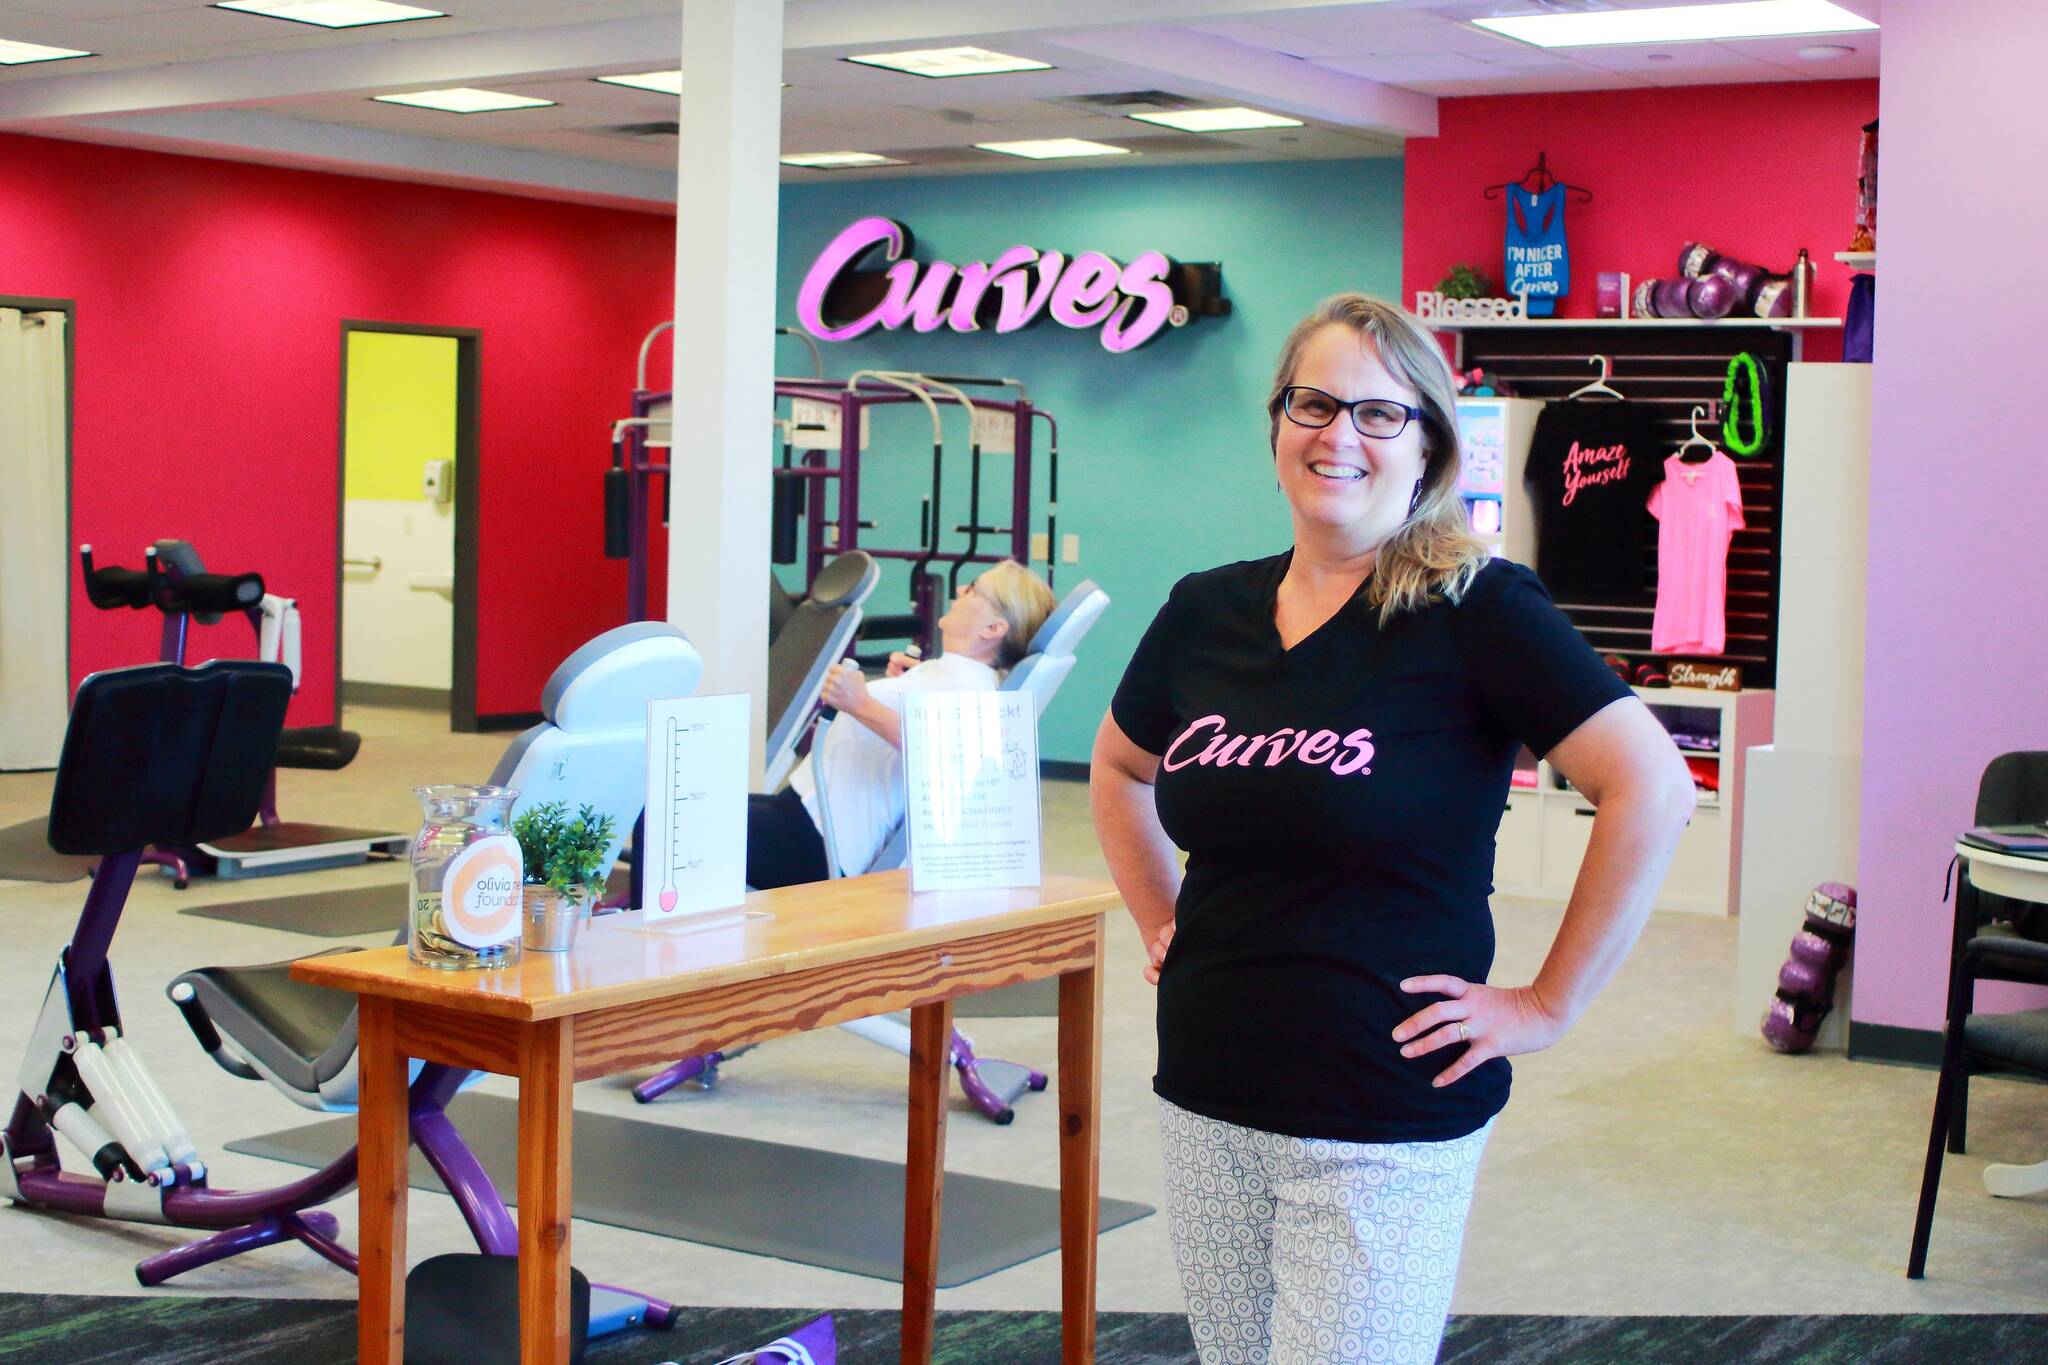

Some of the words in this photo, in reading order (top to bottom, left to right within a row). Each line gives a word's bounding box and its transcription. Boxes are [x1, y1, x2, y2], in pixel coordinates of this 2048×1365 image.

[1508, 246, 1525, 261] I'M
[1526, 244, 1563, 261] NICER
[797, 215, 1174, 353] Curves
[1515, 262, 1553, 278] AFTER
[1416, 290, 1528, 320] Blessed
[1563, 441, 1627, 475] Amaze
[1562, 456, 1631, 507] Yourself
[1668, 663, 1737, 689] Strength
[1163, 714, 1375, 776] Curves
[477, 877, 511, 891] olivia
[417, 899, 429, 911] 20
